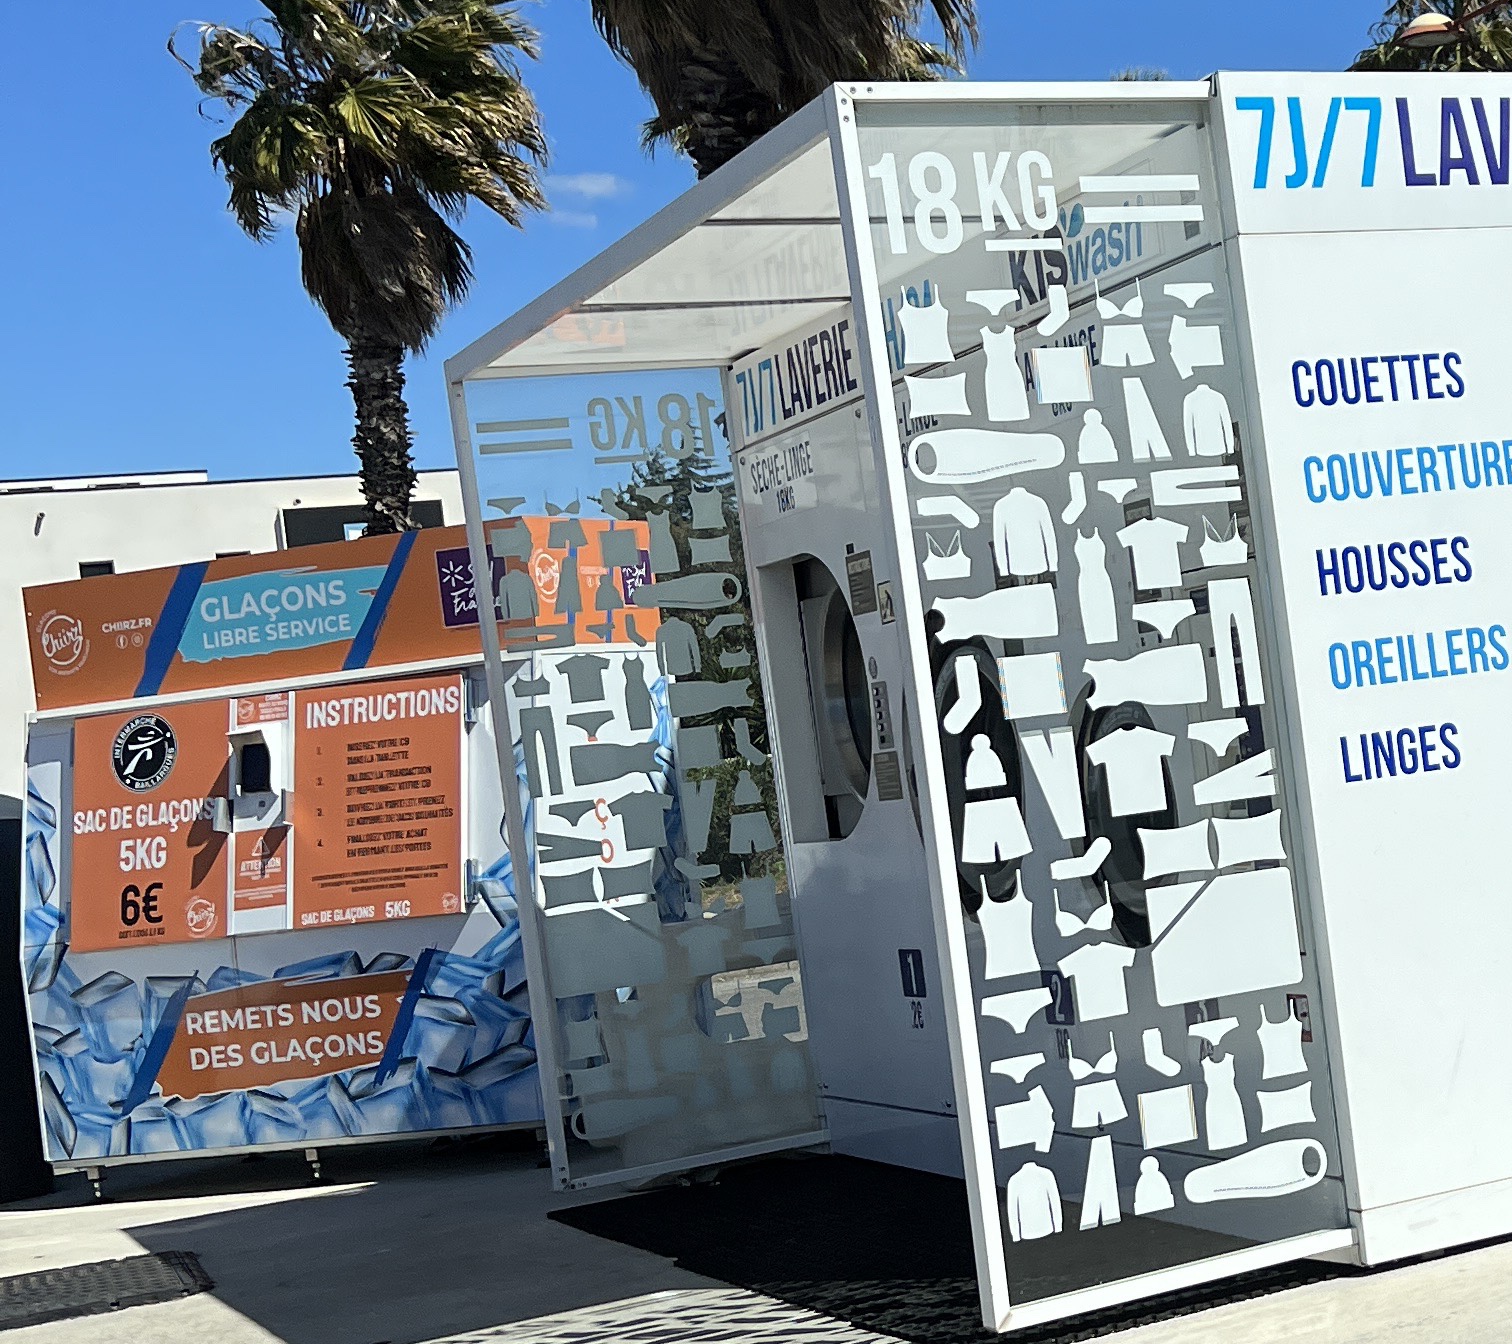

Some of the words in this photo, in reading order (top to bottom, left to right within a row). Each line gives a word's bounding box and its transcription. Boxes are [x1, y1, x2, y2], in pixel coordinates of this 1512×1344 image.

[1235, 95, 1383, 189] 7J/7
[868, 151, 964, 254] 18
[972, 150, 1059, 232] KG
[774, 319, 857, 420] LAVERIE
[1291, 351, 1466, 408] COUETTES
[750, 440, 813, 495] SÈCHE-LINGE
[1315, 536, 1473, 596] HOUSSES
[201, 579, 347, 622] GLAÇONS
[203, 625, 261, 650] LIBRE
[265, 613, 351, 642] SERVICE
[1328, 624, 1510, 690] OREILLERS
[306, 685, 460, 729] INSTRUCTIONS
[1340, 722, 1462, 784] LINGES
[74, 808, 107, 835] SAC
[110, 805, 133, 831] DE
[136, 797, 216, 833] GLAÇONS
[119, 836, 167, 872] 5KG
[120, 882, 164, 926] 6€
[301, 911, 319, 926] SAC
[320, 910, 333, 923] DE
[334, 905, 375, 924] GLAÇONS
[385, 900, 411, 918] 5KG
[907, 953, 917, 995] 1
[185, 1003, 294, 1035] REMETS
[300, 994, 382, 1025] NOUS
[189, 1043, 244, 1071] DES
[250, 1031, 384, 1066] GLAÇONS
